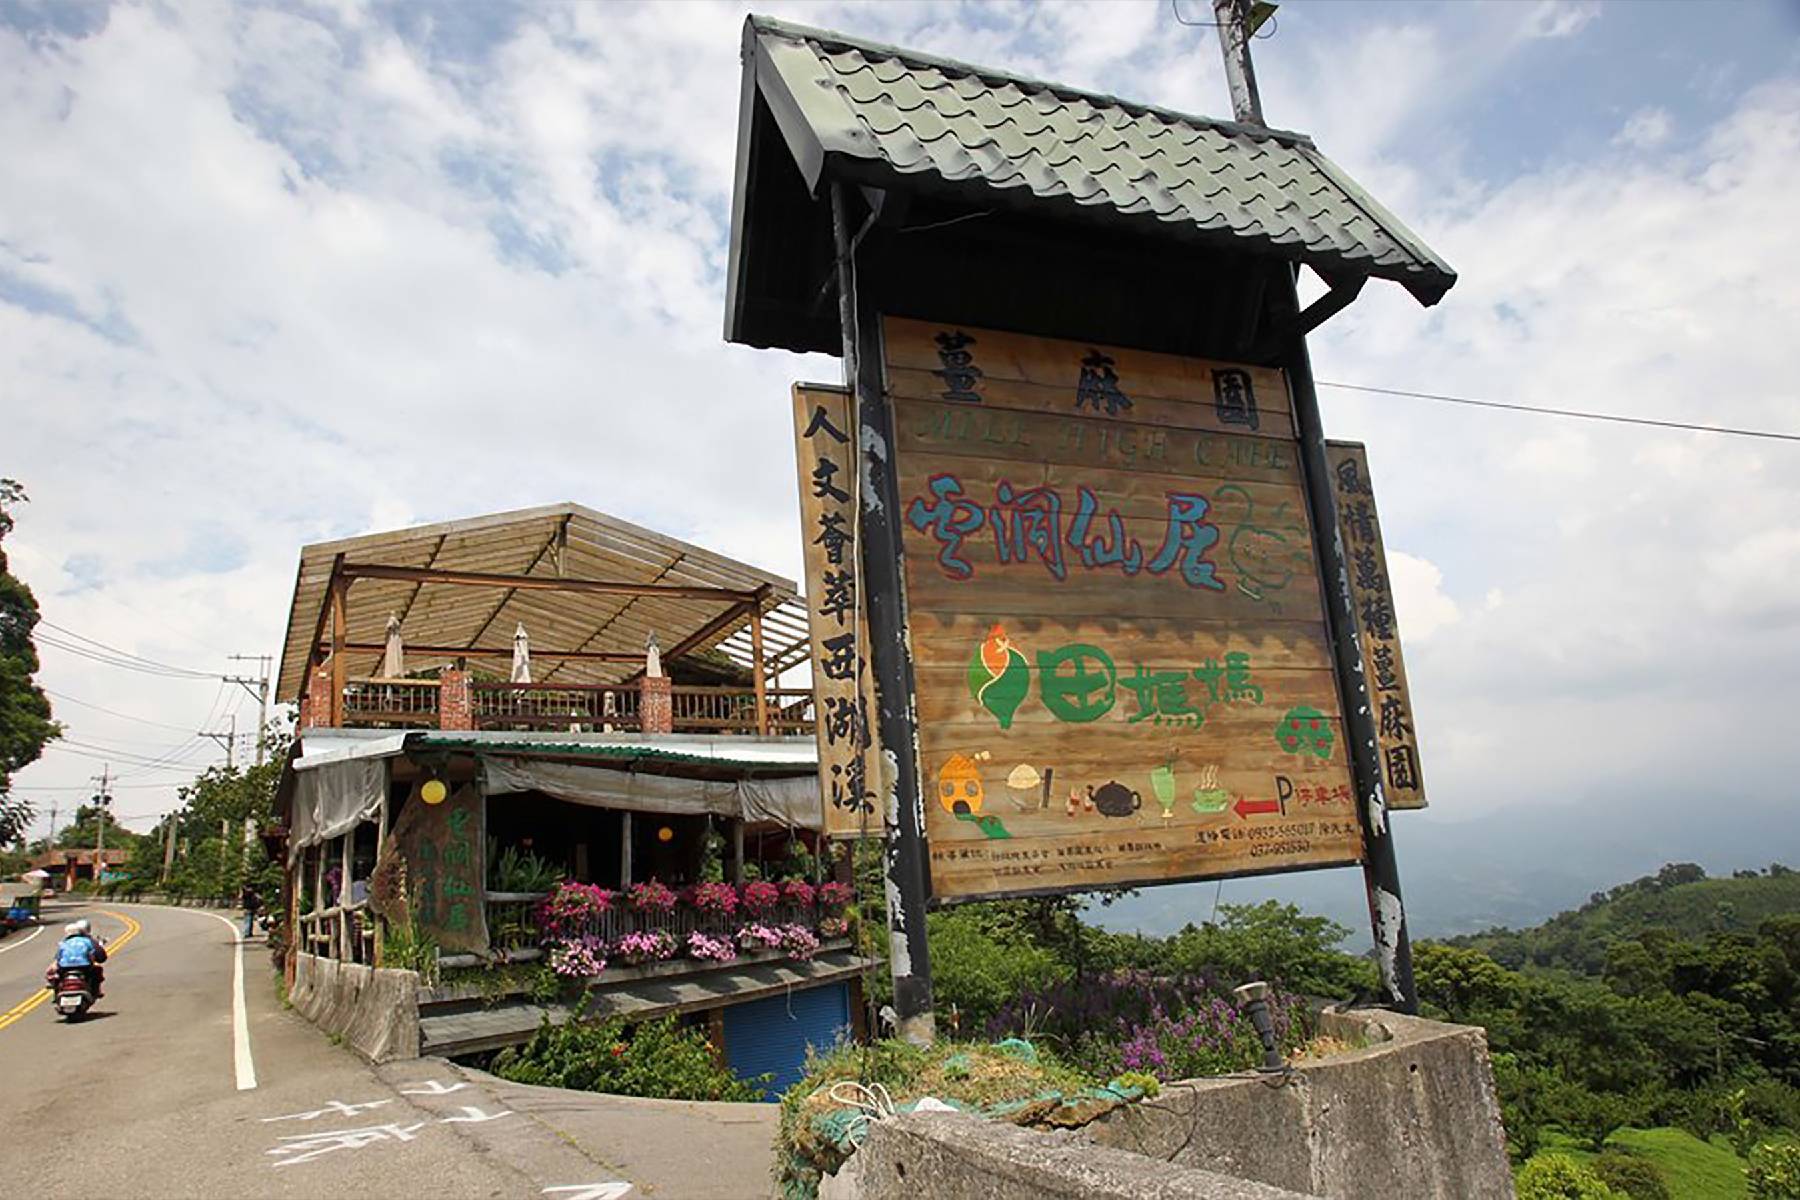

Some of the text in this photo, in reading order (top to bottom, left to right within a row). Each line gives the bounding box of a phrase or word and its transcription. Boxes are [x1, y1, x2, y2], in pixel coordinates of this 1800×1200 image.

[934, 330, 1260, 432] 薑麻園
[907, 473, 1225, 592] 雲洞仙居
[803, 405, 877, 814] 人文薈萃西湖溪
[1336, 458, 1419, 792] 風情萬種薑麻園
[1036, 643, 1264, 729] 田媽媽
